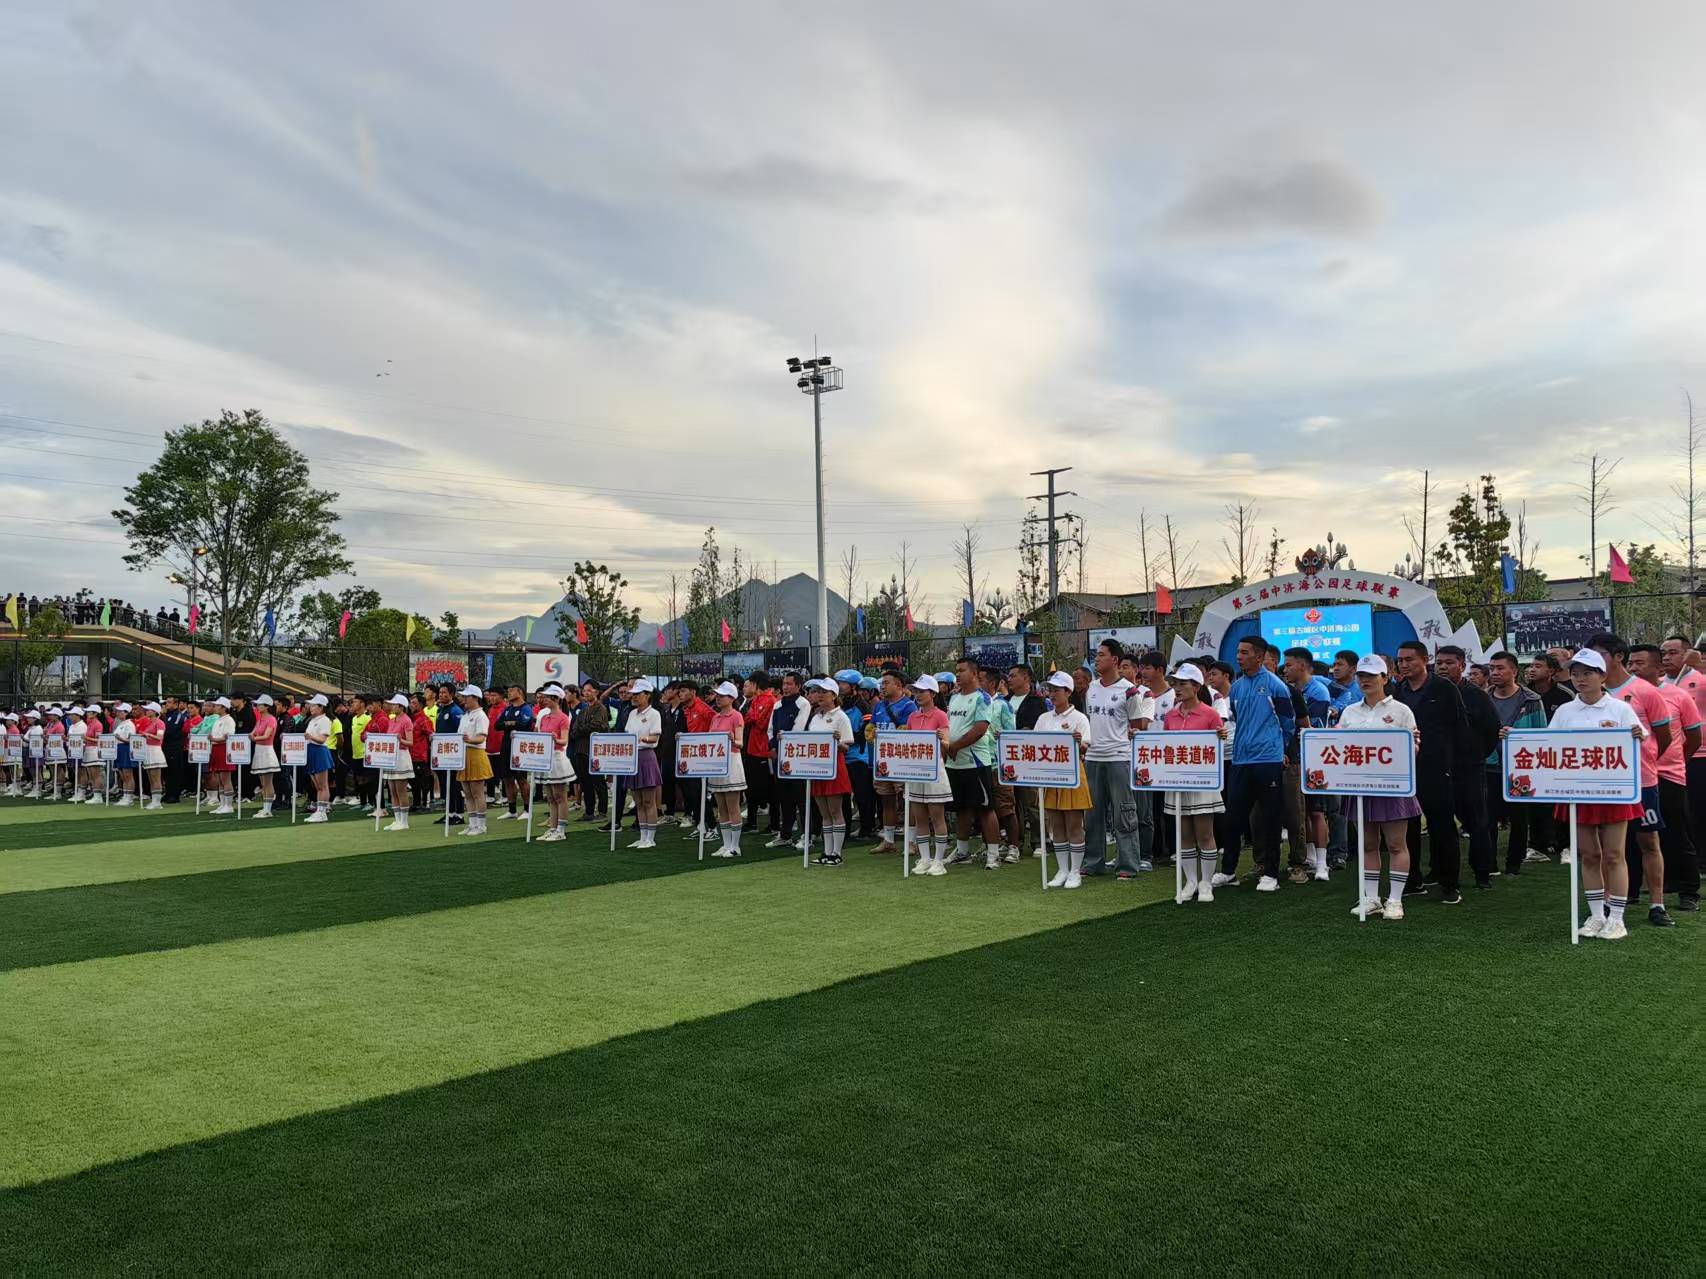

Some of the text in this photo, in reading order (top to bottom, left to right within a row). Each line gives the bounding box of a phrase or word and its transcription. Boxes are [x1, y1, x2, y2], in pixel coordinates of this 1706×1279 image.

[1232, 578, 1400, 610] 第三届中济海公园足球联赛
[680, 743, 726, 759] 丽江饿了么
[784, 742, 831, 759] 沧江同盟
[1006, 744, 1069, 763] 玉湖文旅
[1138, 745, 1216, 765] 东中鲁美道畅
[1320, 744, 1393, 766] 公海FC
[1513, 746, 1628, 770] 金灿足球队
